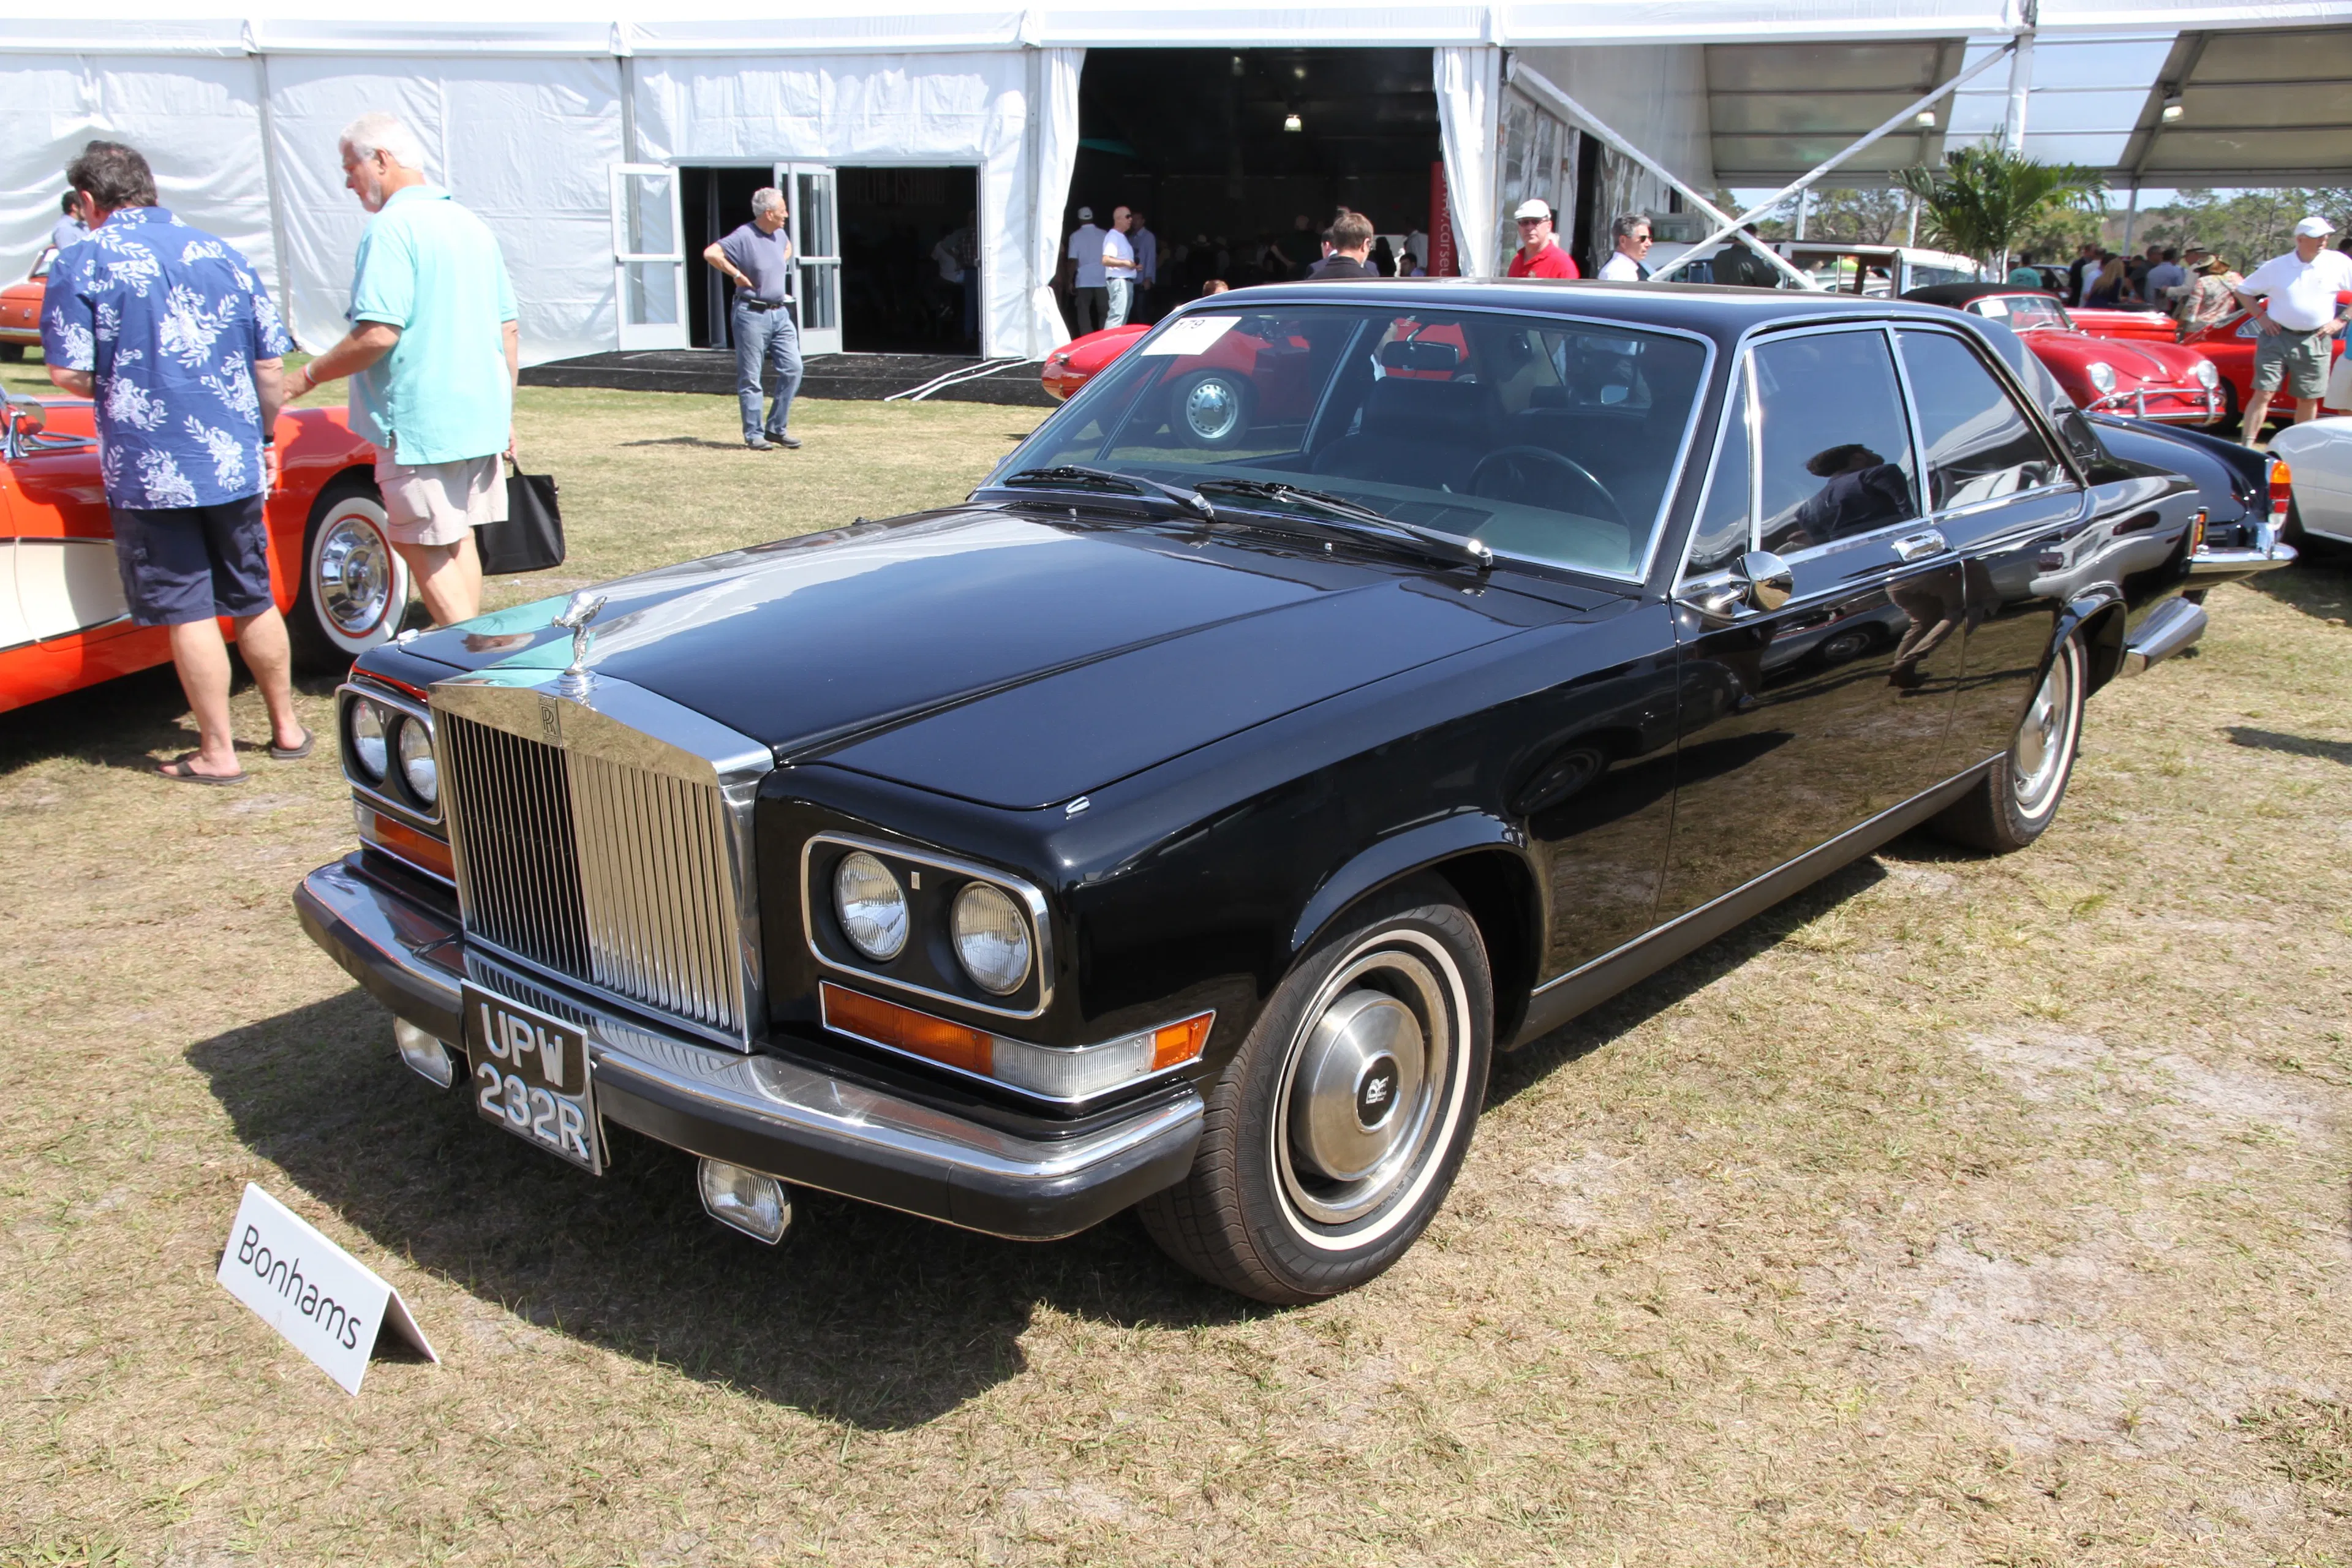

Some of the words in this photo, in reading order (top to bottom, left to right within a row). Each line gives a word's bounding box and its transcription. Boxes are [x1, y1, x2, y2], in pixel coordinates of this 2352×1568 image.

[1175, 319, 1205, 330] 179
[481, 1003, 563, 1087] UPW
[477, 1062, 589, 1159] 232R
[238, 1224, 361, 1349] Bonhams
